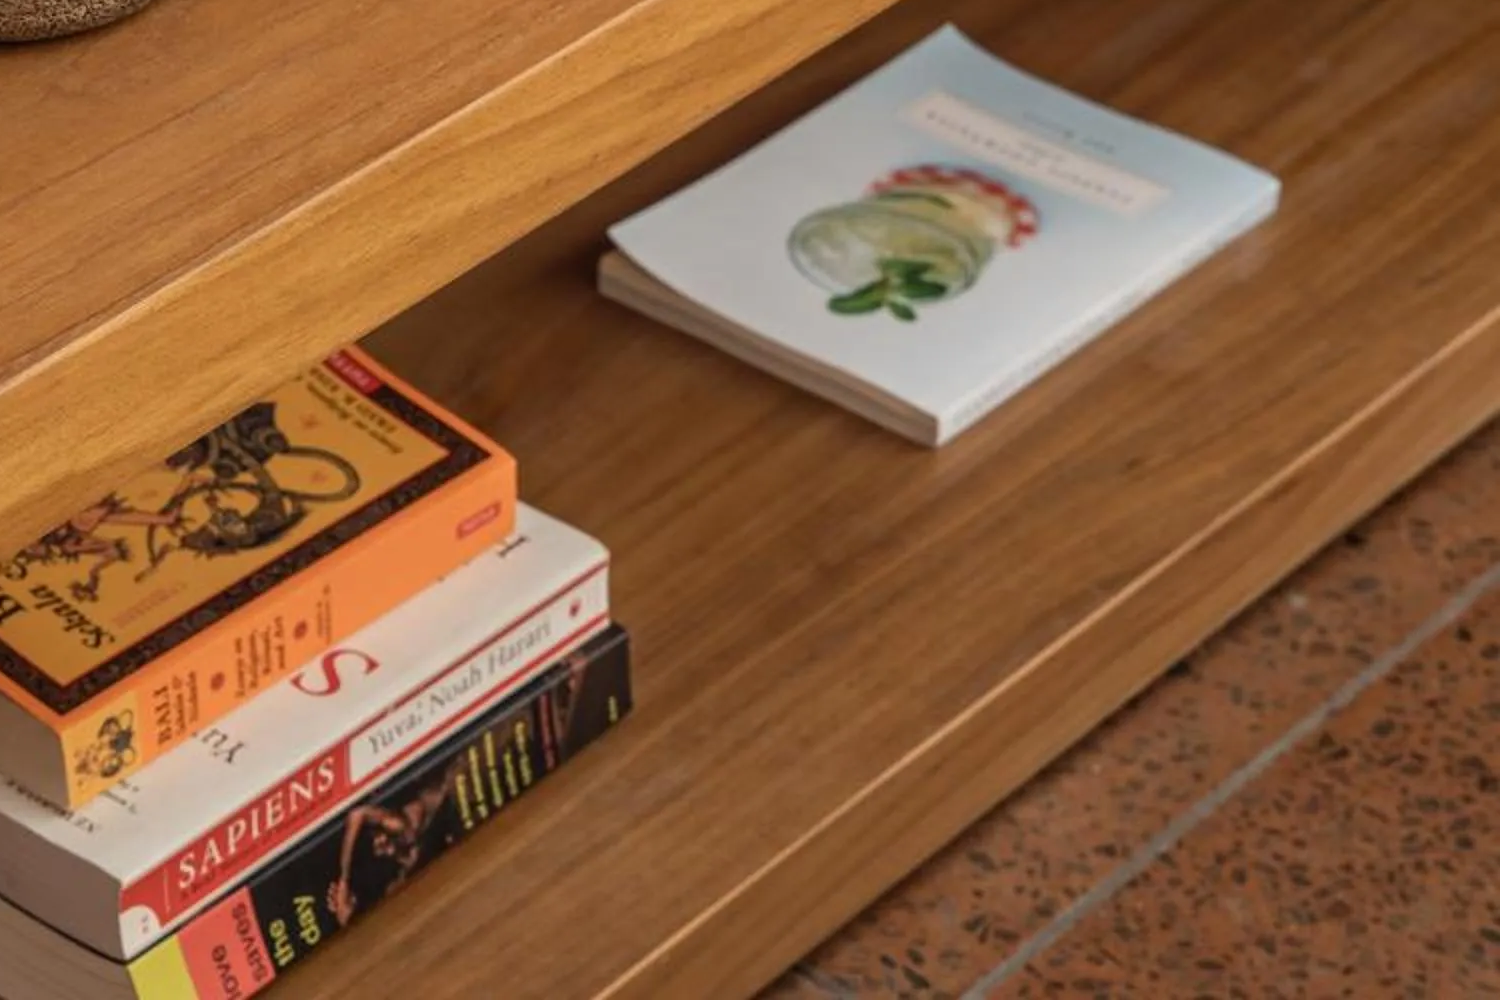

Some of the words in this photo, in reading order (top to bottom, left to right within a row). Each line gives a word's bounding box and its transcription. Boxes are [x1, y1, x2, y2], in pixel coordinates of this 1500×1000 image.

[29, 584, 115, 649] Sekala
[488, 622, 552, 676] Harari
[178, 756, 335, 890] SAPIENS
[268, 918, 295, 966] the
[293, 895, 321, 945] day
